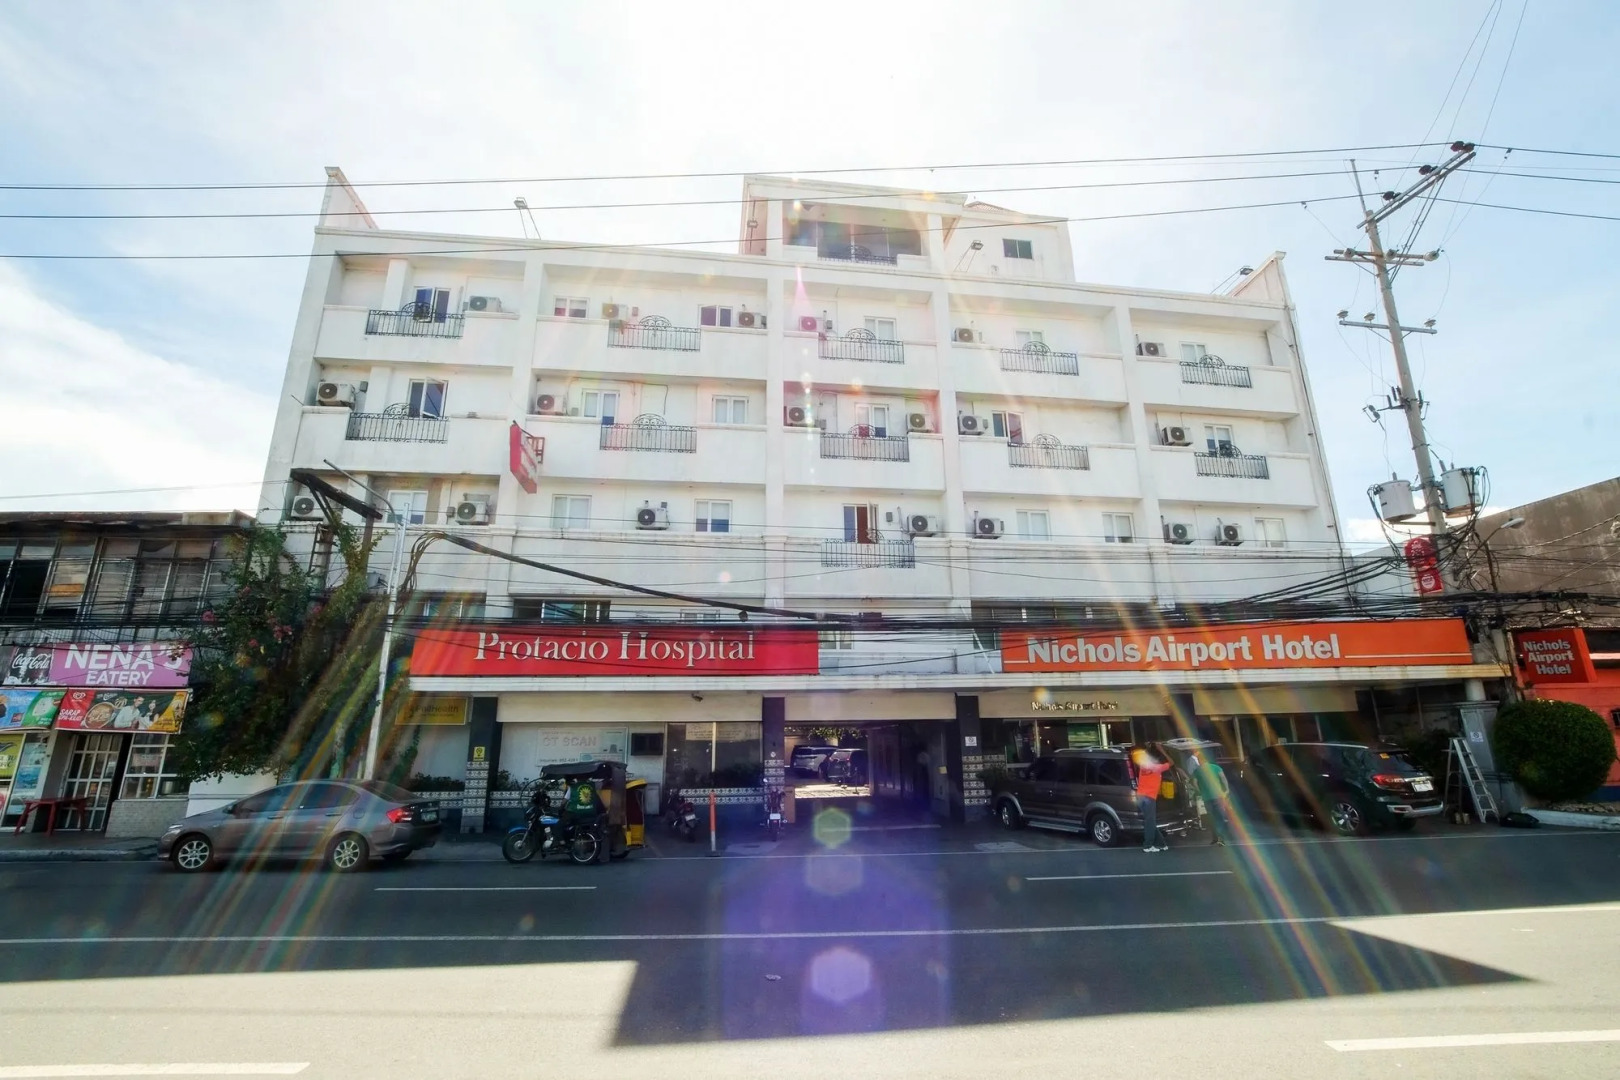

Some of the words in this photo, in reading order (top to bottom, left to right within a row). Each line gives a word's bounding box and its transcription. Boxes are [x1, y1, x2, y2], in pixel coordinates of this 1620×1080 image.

[473, 631, 609, 660] Protacio
[617, 631, 756, 667] Hospital
[1027, 636, 1141, 663] Nichols
[1145, 635, 1253, 667] Airport
[1261, 633, 1341, 660] Hotel
[1522, 639, 1571, 652] Nichols
[12, 653, 52, 669] Coca-Cola
[1528, 650, 1575, 663] Airport
[1536, 663, 1572, 675] Hotel
[85, 670, 153, 685] EATERY
[59, 708, 81, 716] SARAP
[543, 736, 560, 747] CT
[562, 735, 598, 747] SCAN
